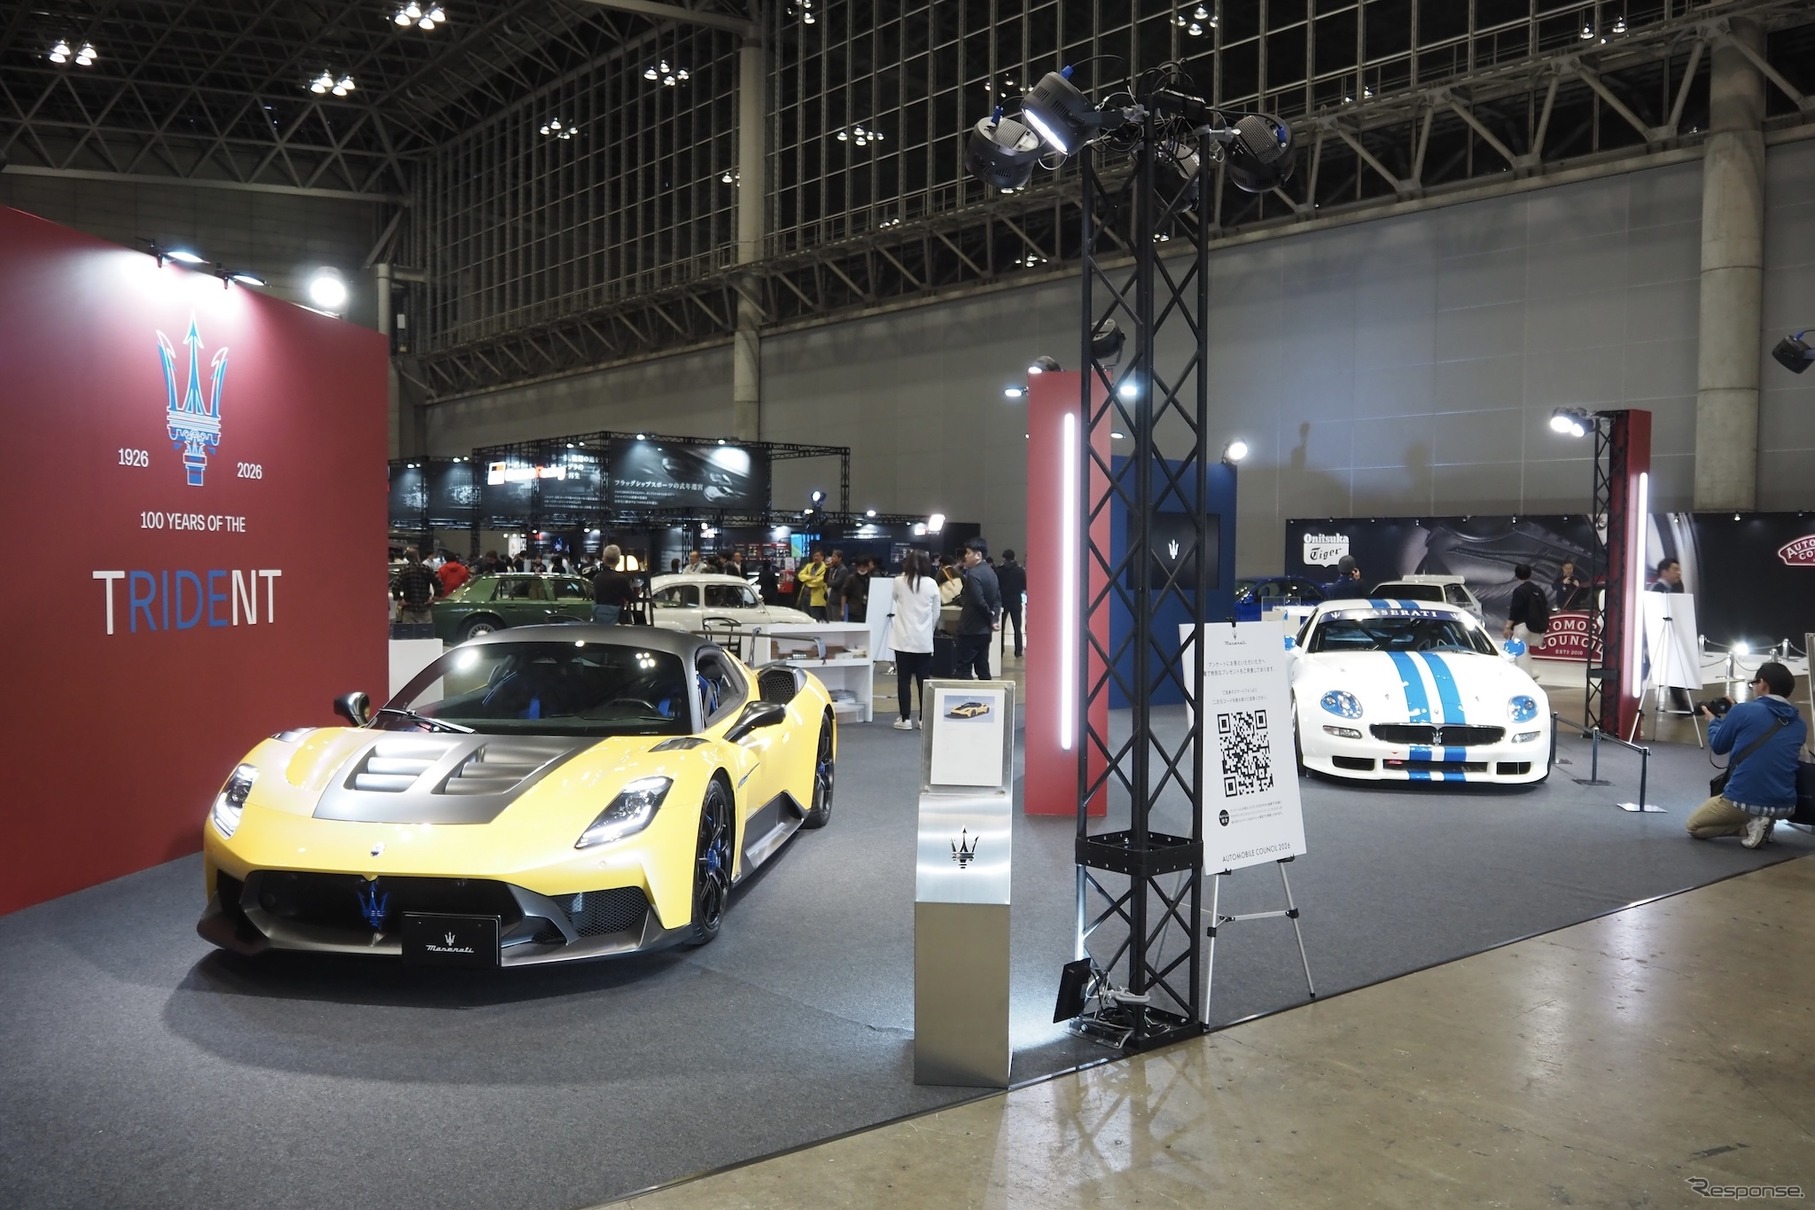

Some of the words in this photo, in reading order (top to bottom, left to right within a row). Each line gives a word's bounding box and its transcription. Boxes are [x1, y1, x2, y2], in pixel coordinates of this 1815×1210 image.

[118, 448, 149, 467] 1926
[237, 462, 263, 480] 2026
[141, 511, 164, 530] 100
[166, 512, 205, 532] YEARS
[207, 515, 224, 532] OF
[225, 516, 246, 533] THE
[1303, 532, 1349, 543] Onitsuka
[1310, 547, 1342, 560] Tiger
[92, 569, 282, 635] TRIDENT
[1358, 608, 1437, 618] ASERATI
[1222, 849, 1255, 862] AUTOMOBILE
[1255, 845, 1278, 856] COUNCIL
[1278, 842, 1291, 851] 2026
[425, 944, 475, 954] Maserati
